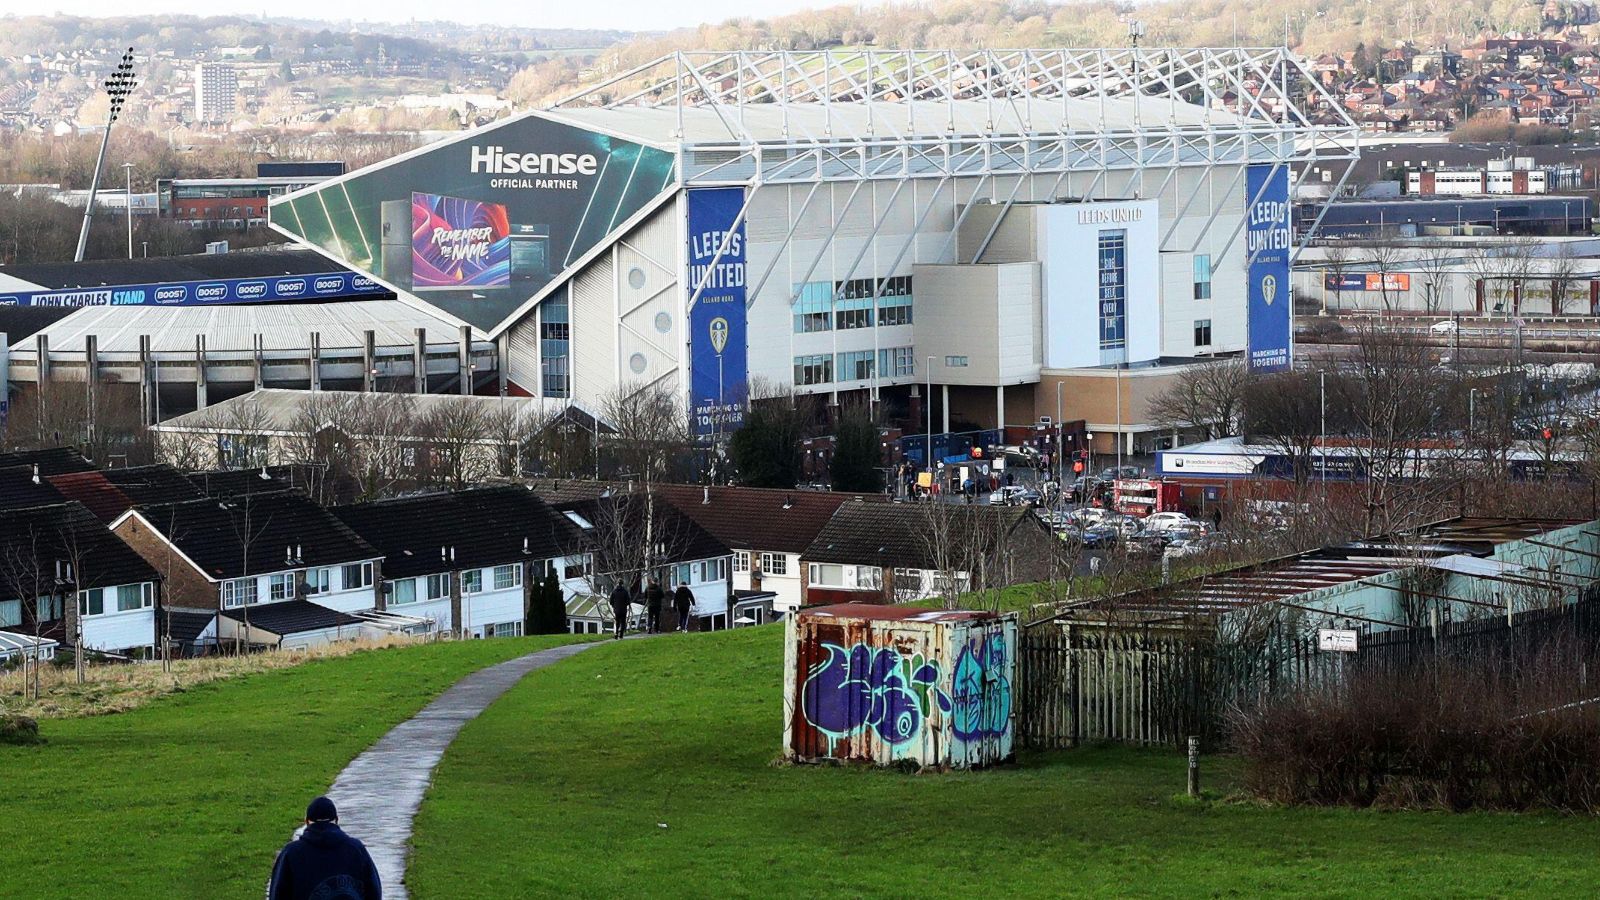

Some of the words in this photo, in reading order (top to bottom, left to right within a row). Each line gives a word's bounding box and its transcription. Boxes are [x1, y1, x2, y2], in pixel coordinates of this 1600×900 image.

[470, 145, 598, 176] Hisense
[490, 178, 533, 189] OFFICIAL
[535, 179, 578, 190] PARTNER
[1077, 209, 1109, 225] LEEDS
[431, 226, 493, 246] REMEMBER
[692, 230, 742, 260] LEEDS
[354, 278, 375, 286] BOOS
[690, 262, 744, 290] UNITED
[238, 285, 265, 294] BOOST
[277, 282, 304, 292] BOOST
[316, 280, 342, 289] BOOST
[157, 290, 185, 299] BOOST
[197, 287, 226, 296] BOOST
[36, 295, 62, 306] JOHN
[63, 292, 108, 307] CHARLES
[112, 290, 146, 305] STAND
[1252, 355, 1287, 368] TOGETHER
